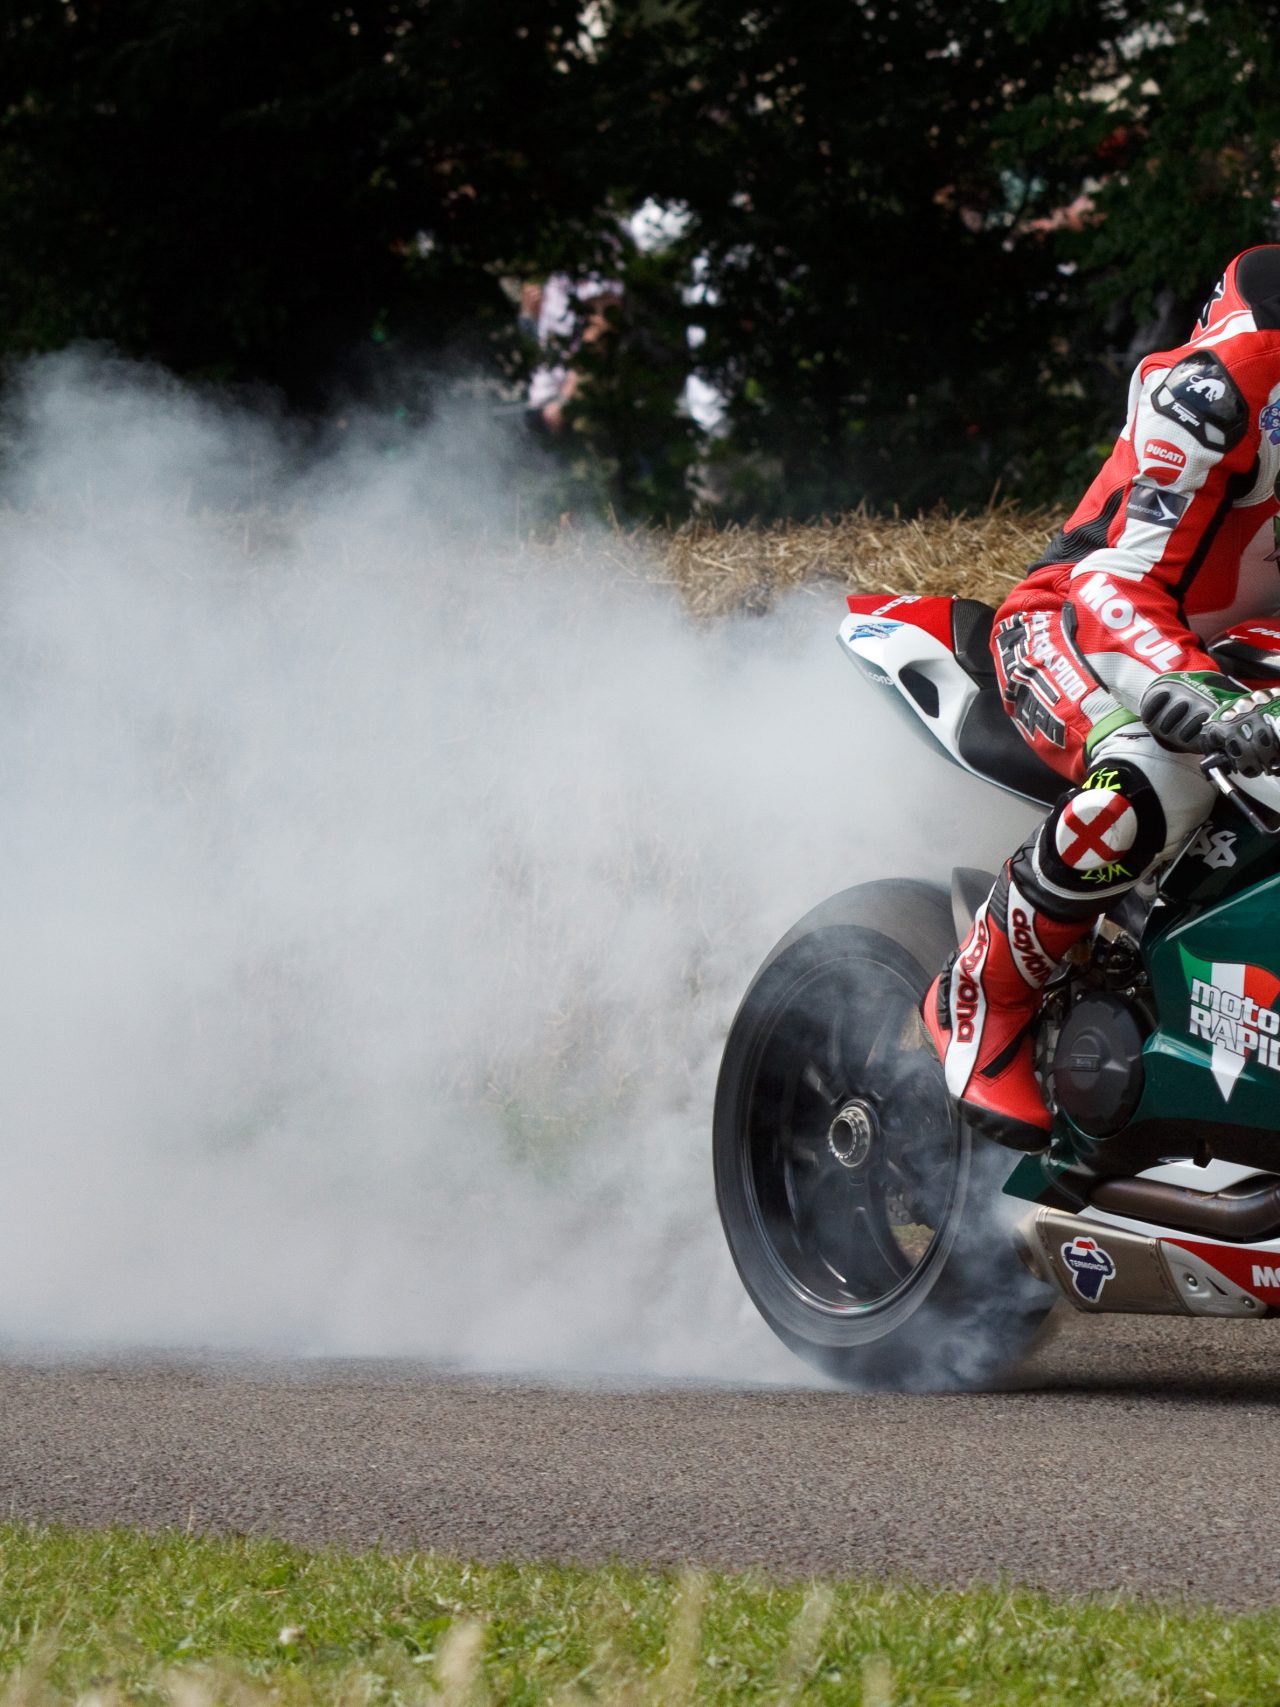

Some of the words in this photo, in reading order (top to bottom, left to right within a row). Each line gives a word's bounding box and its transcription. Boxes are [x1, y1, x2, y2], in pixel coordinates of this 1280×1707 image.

[1145, 443, 1184, 464] DUCATI
[1079, 574, 1184, 673] MOTUL
[1190, 977, 1280, 1035] moto
